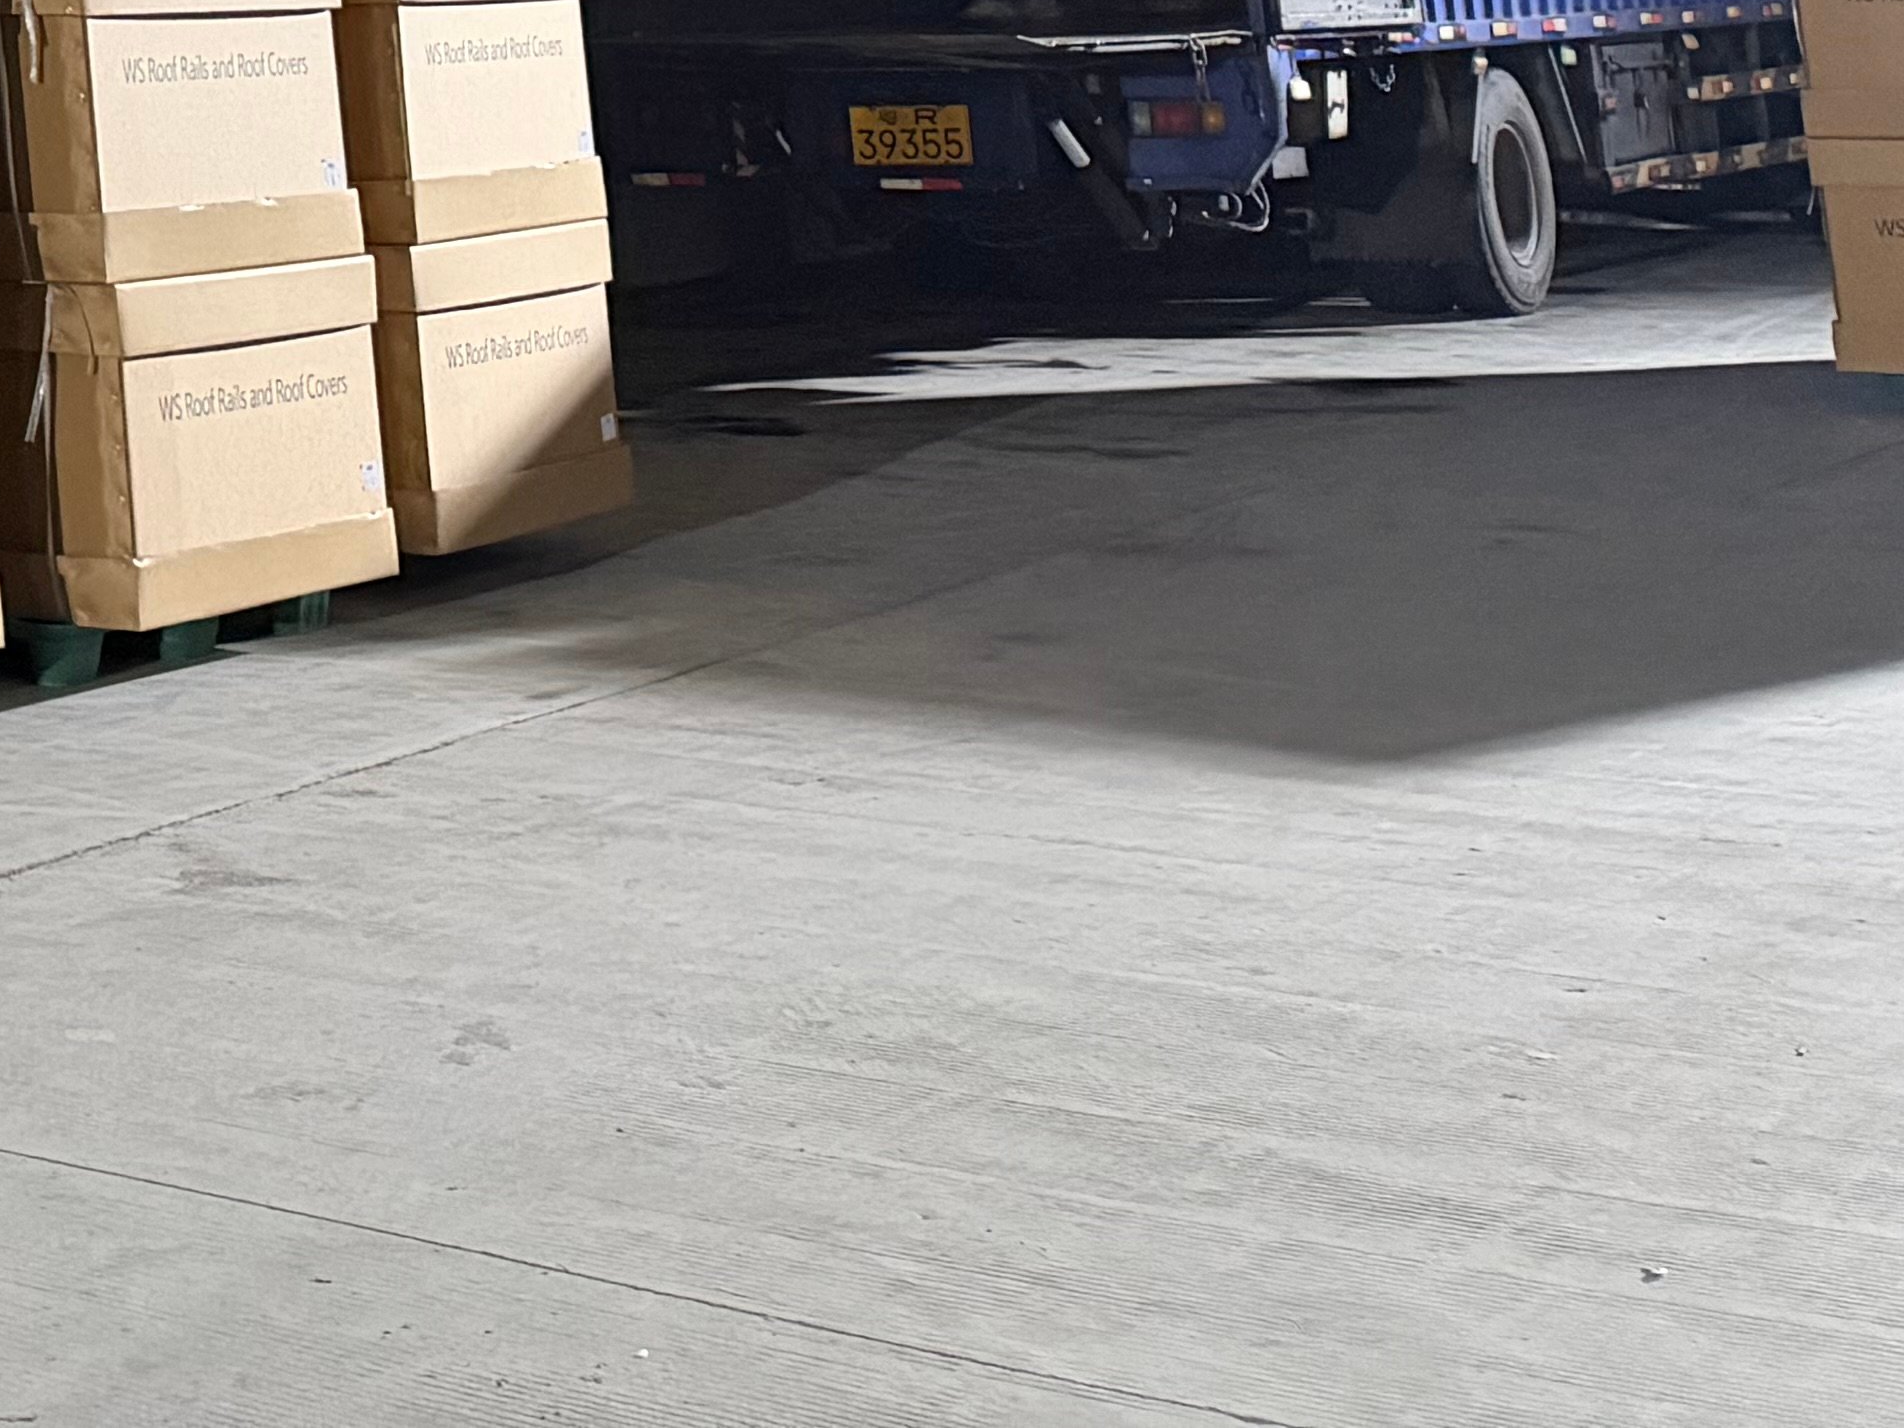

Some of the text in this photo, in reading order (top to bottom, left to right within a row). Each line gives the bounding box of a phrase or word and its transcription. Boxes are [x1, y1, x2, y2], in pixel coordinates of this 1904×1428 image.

[122, 51, 308, 84] WS Roof Rails and Roof Covers
[914, 108, 937, 125] R
[857, 127, 964, 160] 39355
[158, 373, 348, 422] WS Roof Rails and Roof Covers
